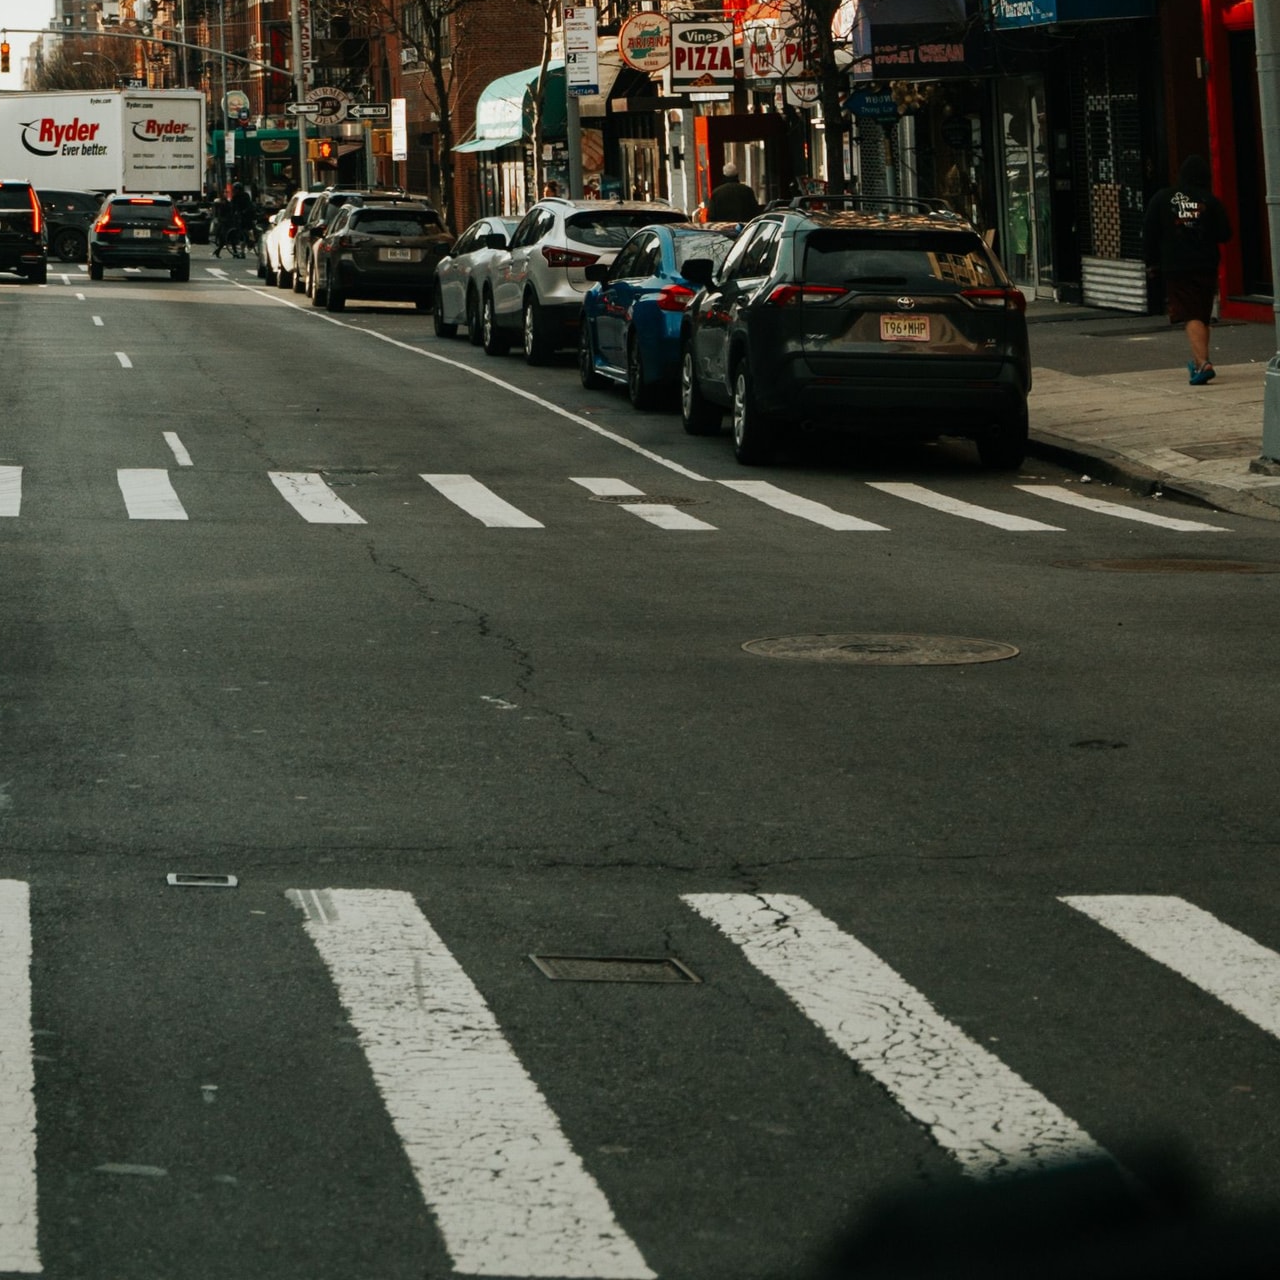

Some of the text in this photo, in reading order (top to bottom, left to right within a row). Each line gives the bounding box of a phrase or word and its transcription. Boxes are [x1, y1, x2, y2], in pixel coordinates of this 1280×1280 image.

[567, 9, 573, 19] 2
[686, 31, 719, 41] Vines
[569, 54, 575, 63] 2
[675, 46, 733, 71] PIZZA
[918, 43, 965, 63] CREAM
[796, 88, 816, 96] ATM
[314, 114, 340, 124] DELI
[39, 117, 100, 148] Ryder
[145, 119, 189, 137] Ryder
[61, 143, 108, 156] Ever better.
